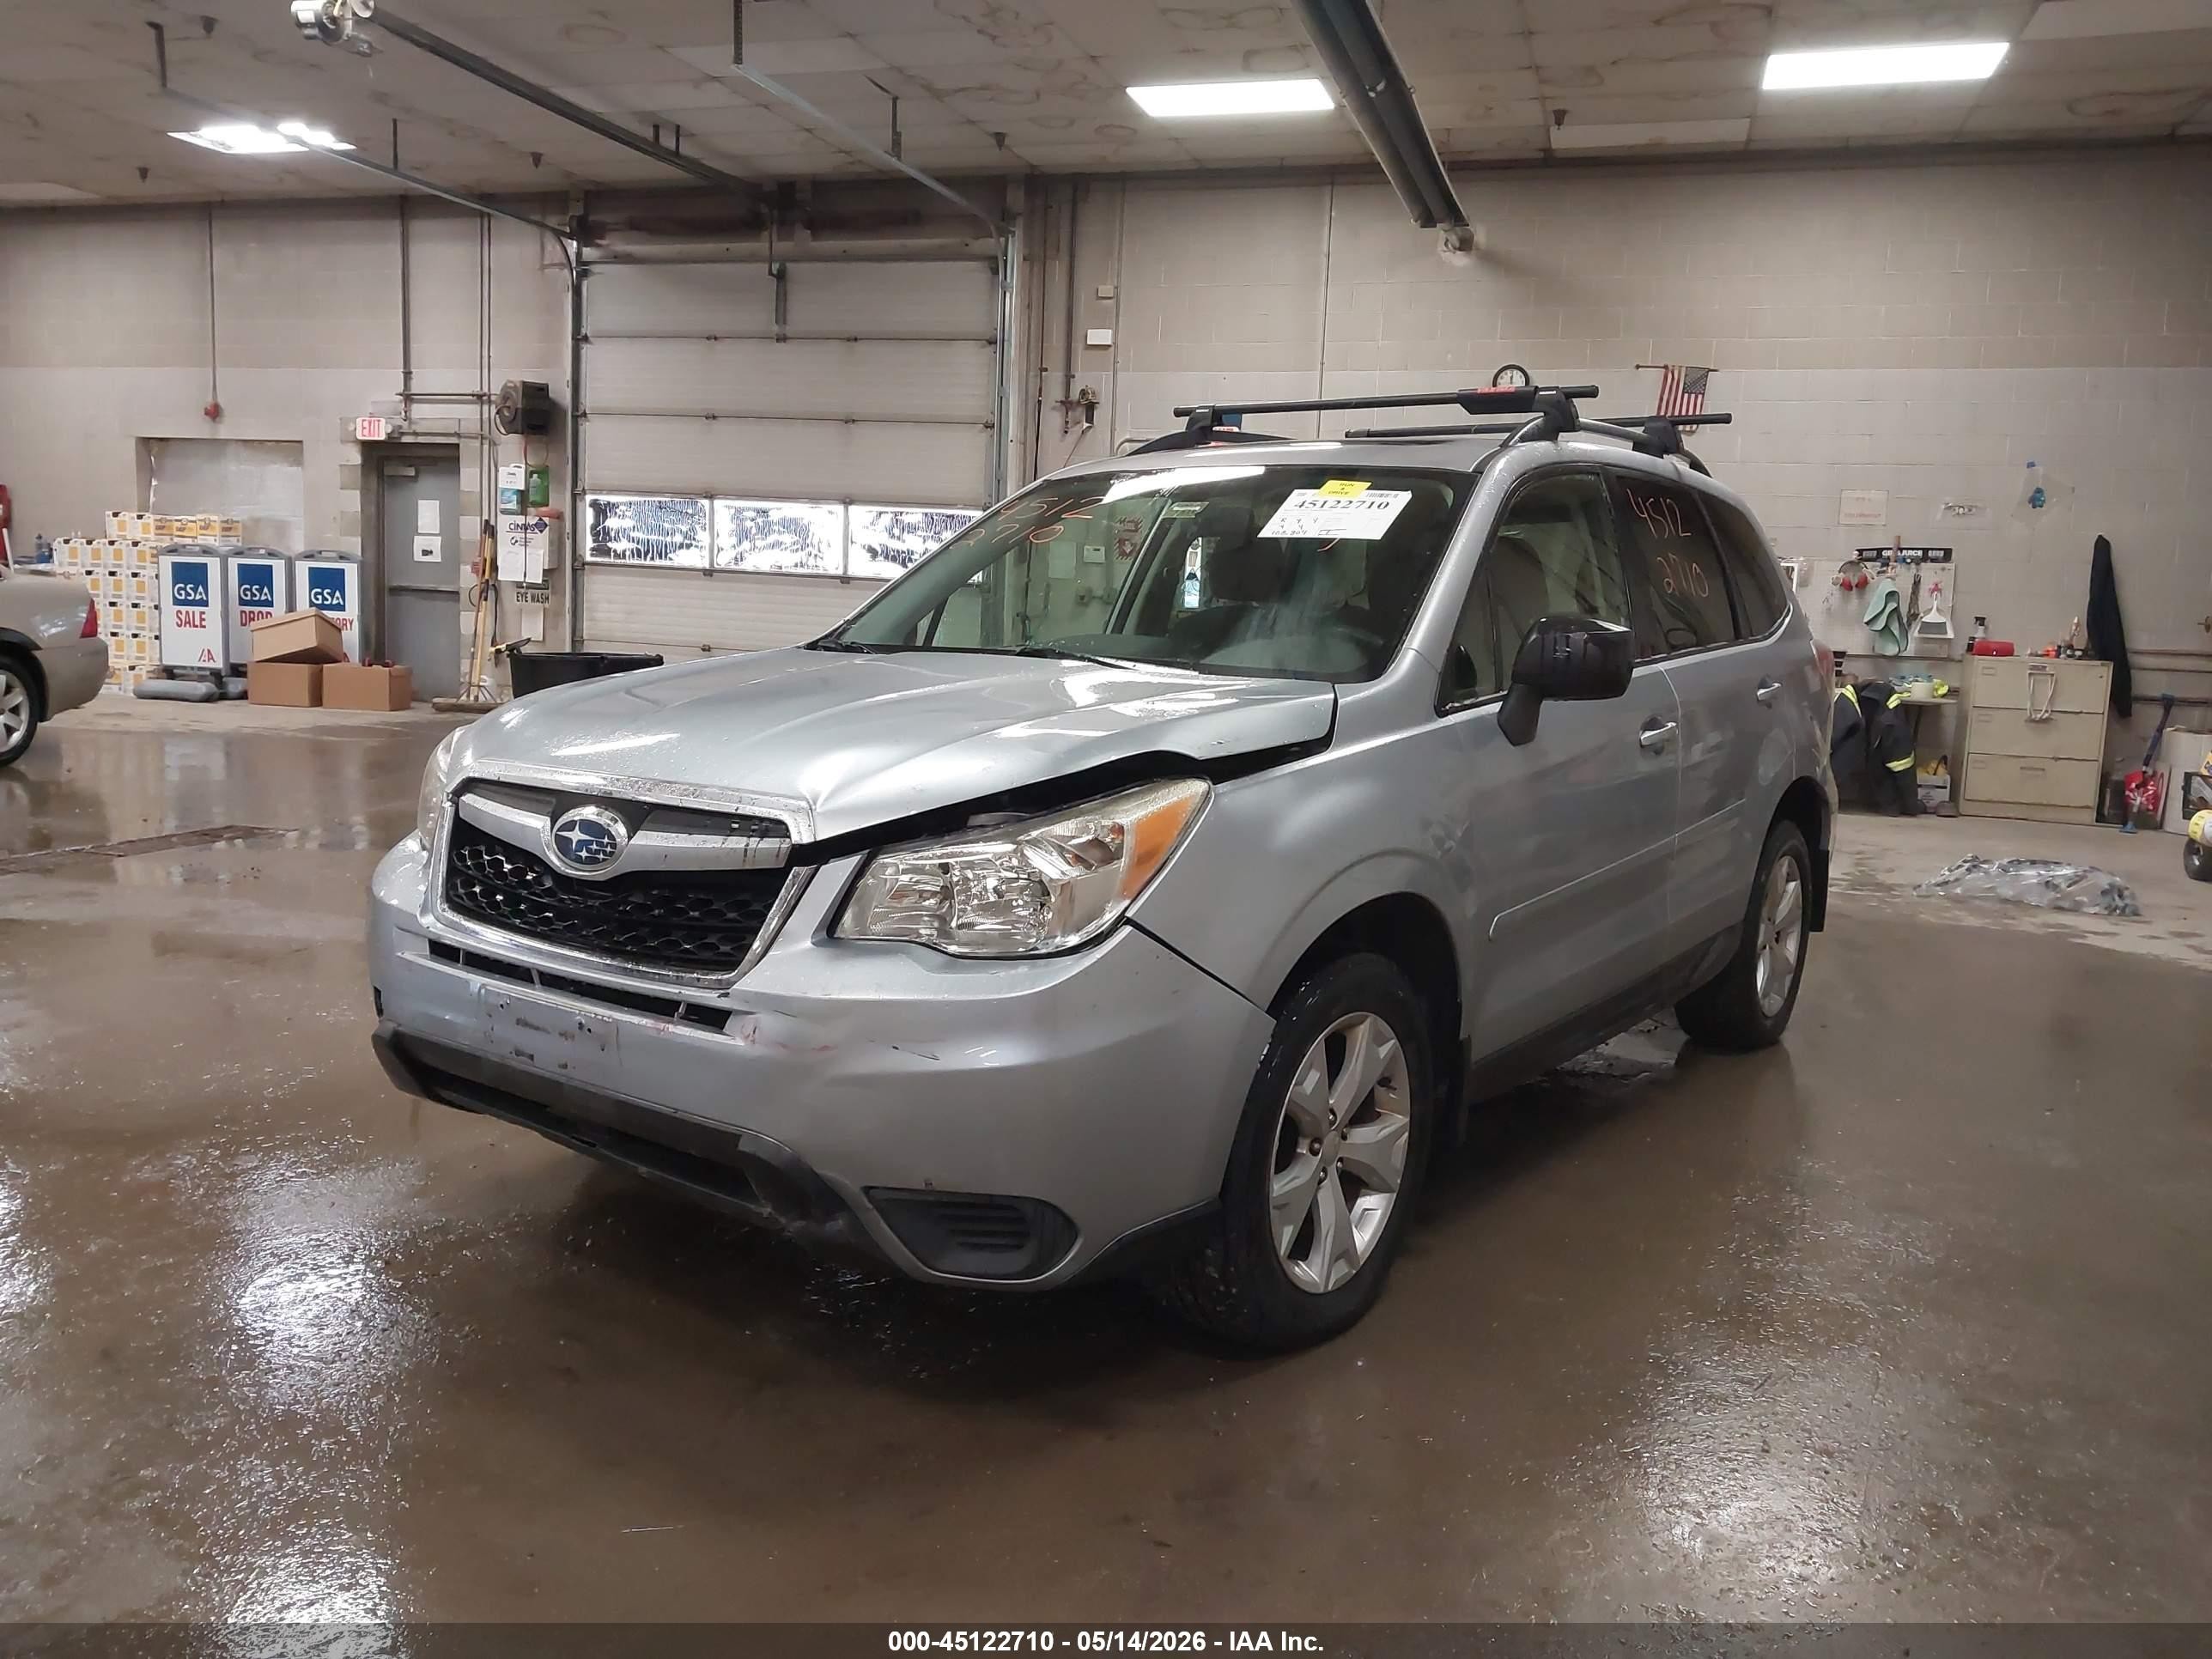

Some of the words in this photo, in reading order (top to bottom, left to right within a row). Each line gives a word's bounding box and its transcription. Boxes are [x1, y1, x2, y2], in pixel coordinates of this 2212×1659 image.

[362, 419, 381, 437] EXIT
[996, 496, 1104, 521] 4512
[1293, 500, 1390, 510] 45122710
[1626, 488, 1692, 539] 4512
[949, 526, 1064, 550] 2710
[1656, 552, 1709, 597] 2710
[173, 584, 207, 600] GSA
[240, 585, 272, 601] GSA
[311, 589, 343, 605] GSA
[516, 591, 528, 602] EYE
[530, 592, 549, 604] WASH
[176, 610, 206, 629] SALE
